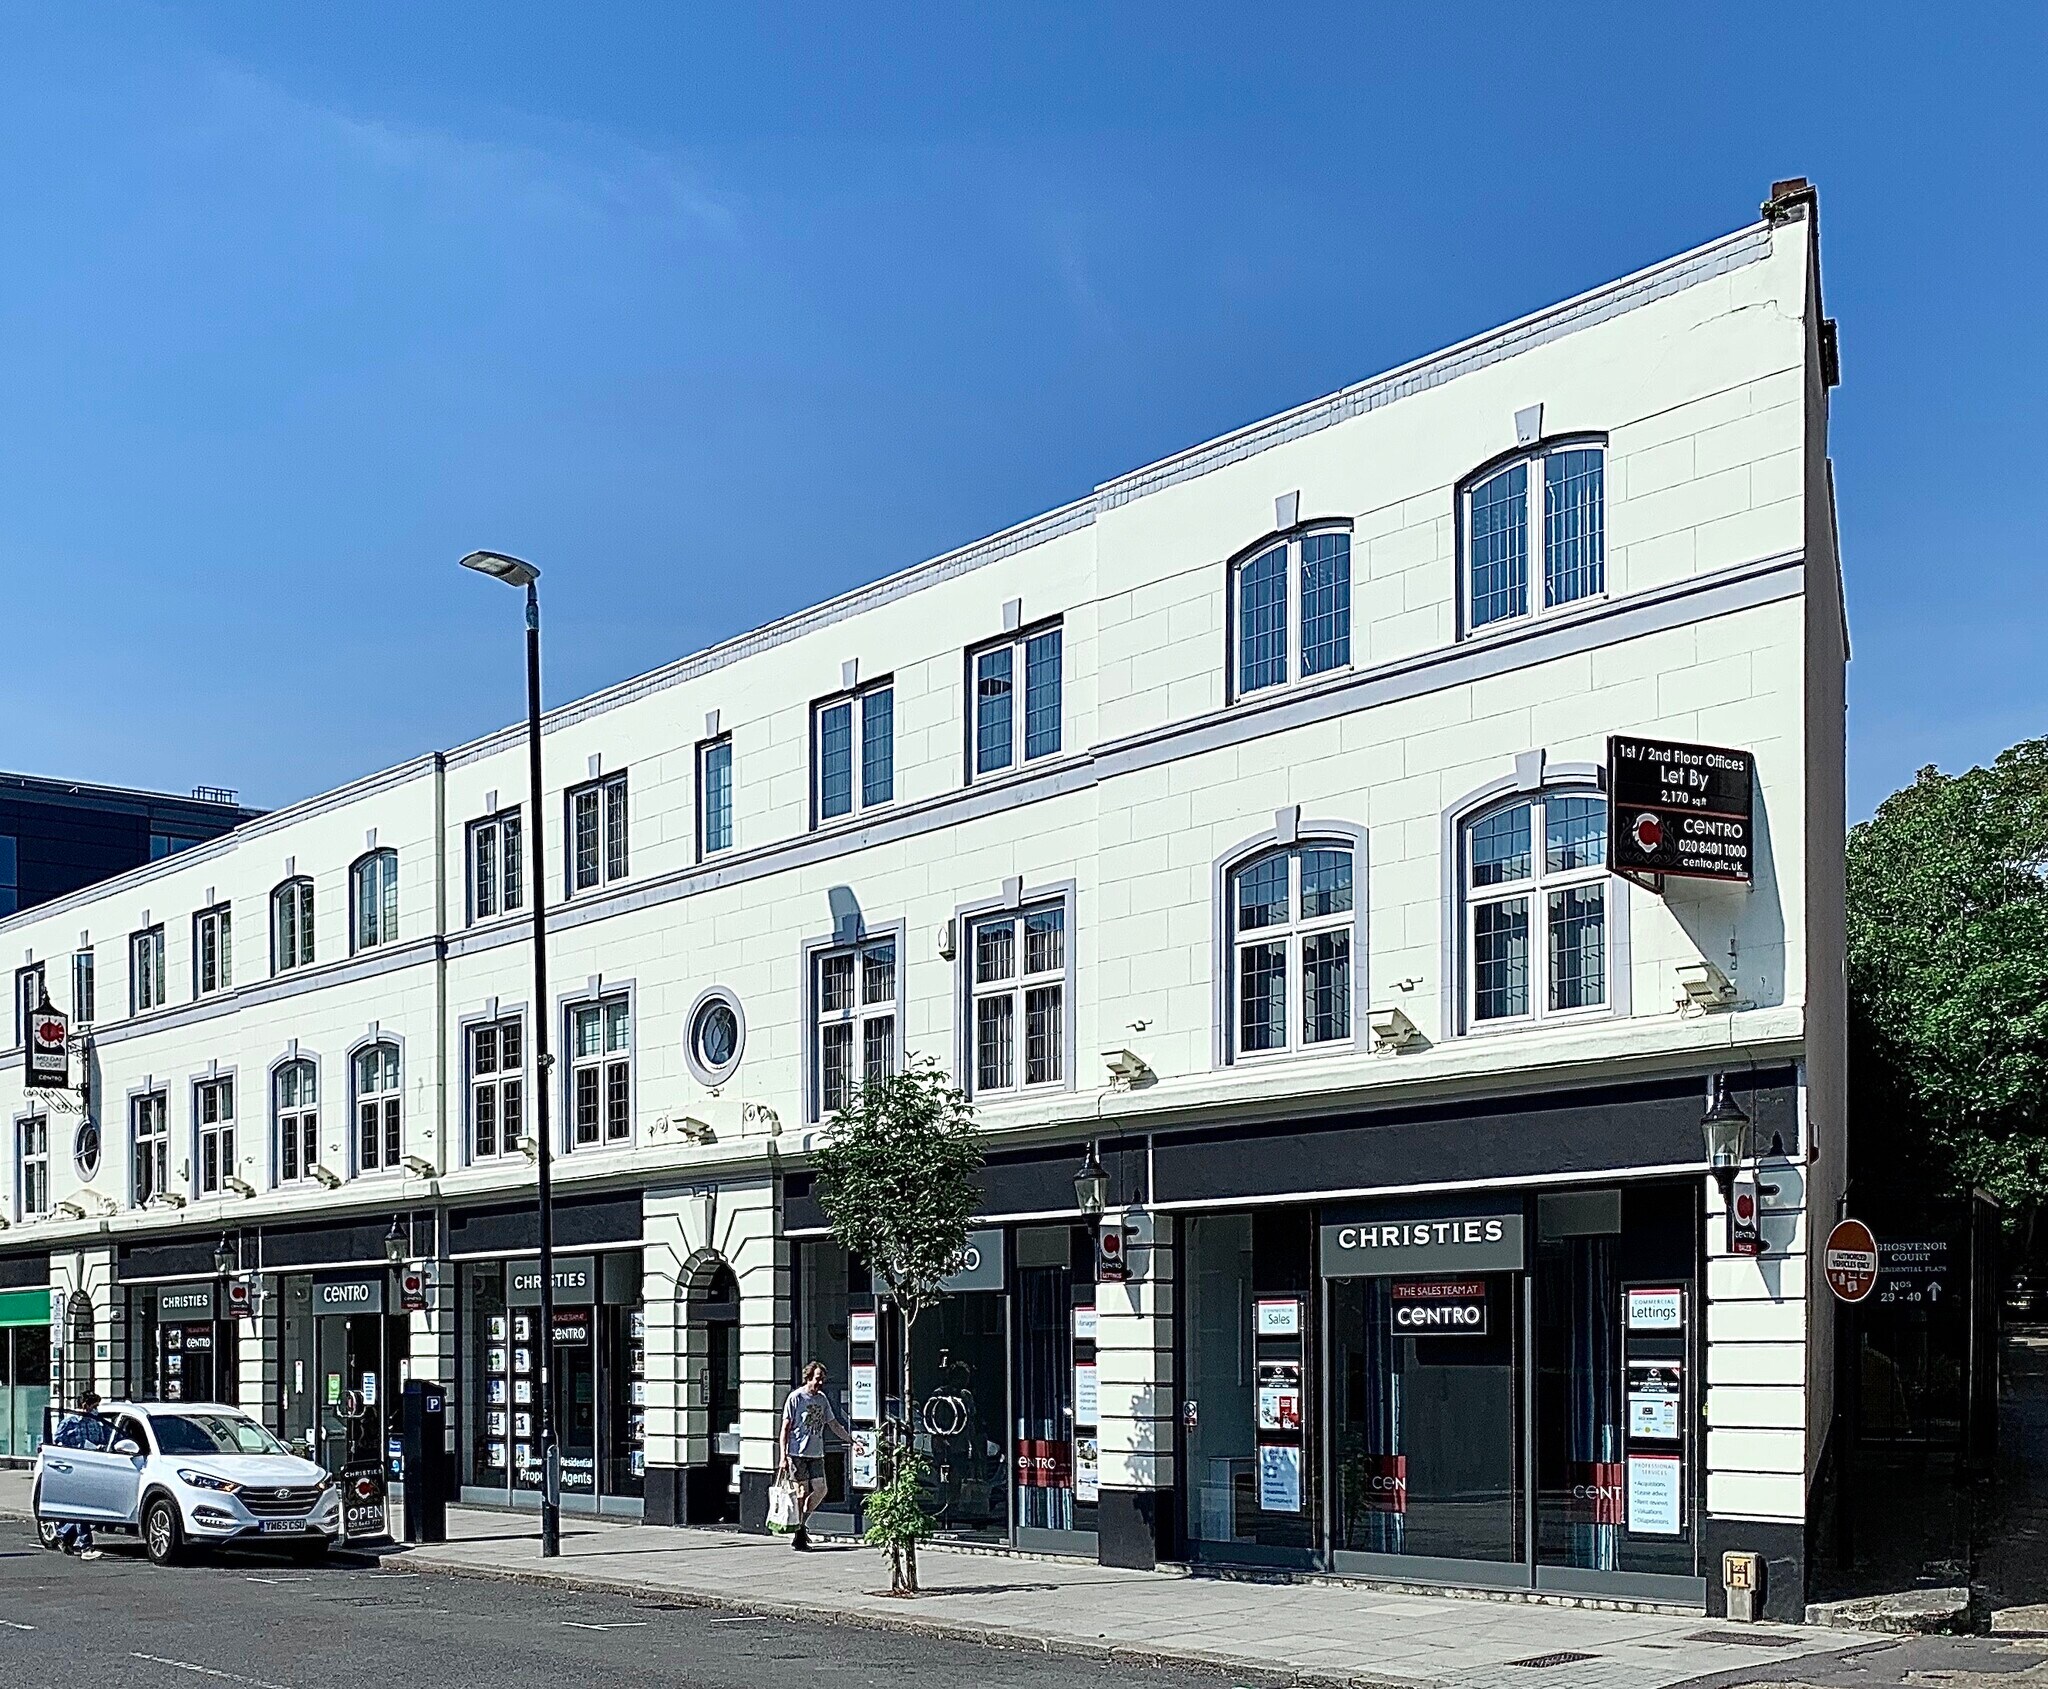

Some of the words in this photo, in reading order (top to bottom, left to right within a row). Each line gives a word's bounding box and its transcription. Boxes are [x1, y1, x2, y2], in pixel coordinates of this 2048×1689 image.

[1620, 744, 1636, 758] 1st
[1639, 746, 1645, 761] /
[1648, 747, 1671, 762] 2nd
[1674, 750, 1703, 766] Floor
[1706, 753, 1745, 772] Offices
[1661, 765, 1685, 785] Let
[1689, 769, 1709, 792] By
[1661, 790, 1689, 804] 2,170
[1679, 839, 1698, 853] 020
[1699, 841, 1722, 856] 8401
[1724, 843, 1747, 858] 1000
[1682, 857, 1743, 872] centro.plc.uk
[1338, 1220, 1503, 1249] CHRISTIES
[1891, 1253, 1931, 1262] COURT
[514, 1272, 586, 1289] CHRTIES
[1399, 1286, 1416, 1296] THE
[1417, 1286, 1441, 1296] SALES
[1441, 1285, 1466, 1295] TEAM
[1466, 1285, 1478, 1294] AT
[1880, 1292, 1895, 1302] 29
[1906, 1292, 1922, 1302] 40
[162, 1294, 208, 1309] CHRISTIES
[1268, 1313, 1290, 1325] Sales
[1631, 1306, 1676, 1321] Lettings
[430, 1398, 439, 1409] P
[560, 1456, 593, 1468] Residential
[561, 1470, 592, 1486] Agents
[347, 1505, 383, 1521] OPEN
[288, 1520, 305, 1530] CSU
